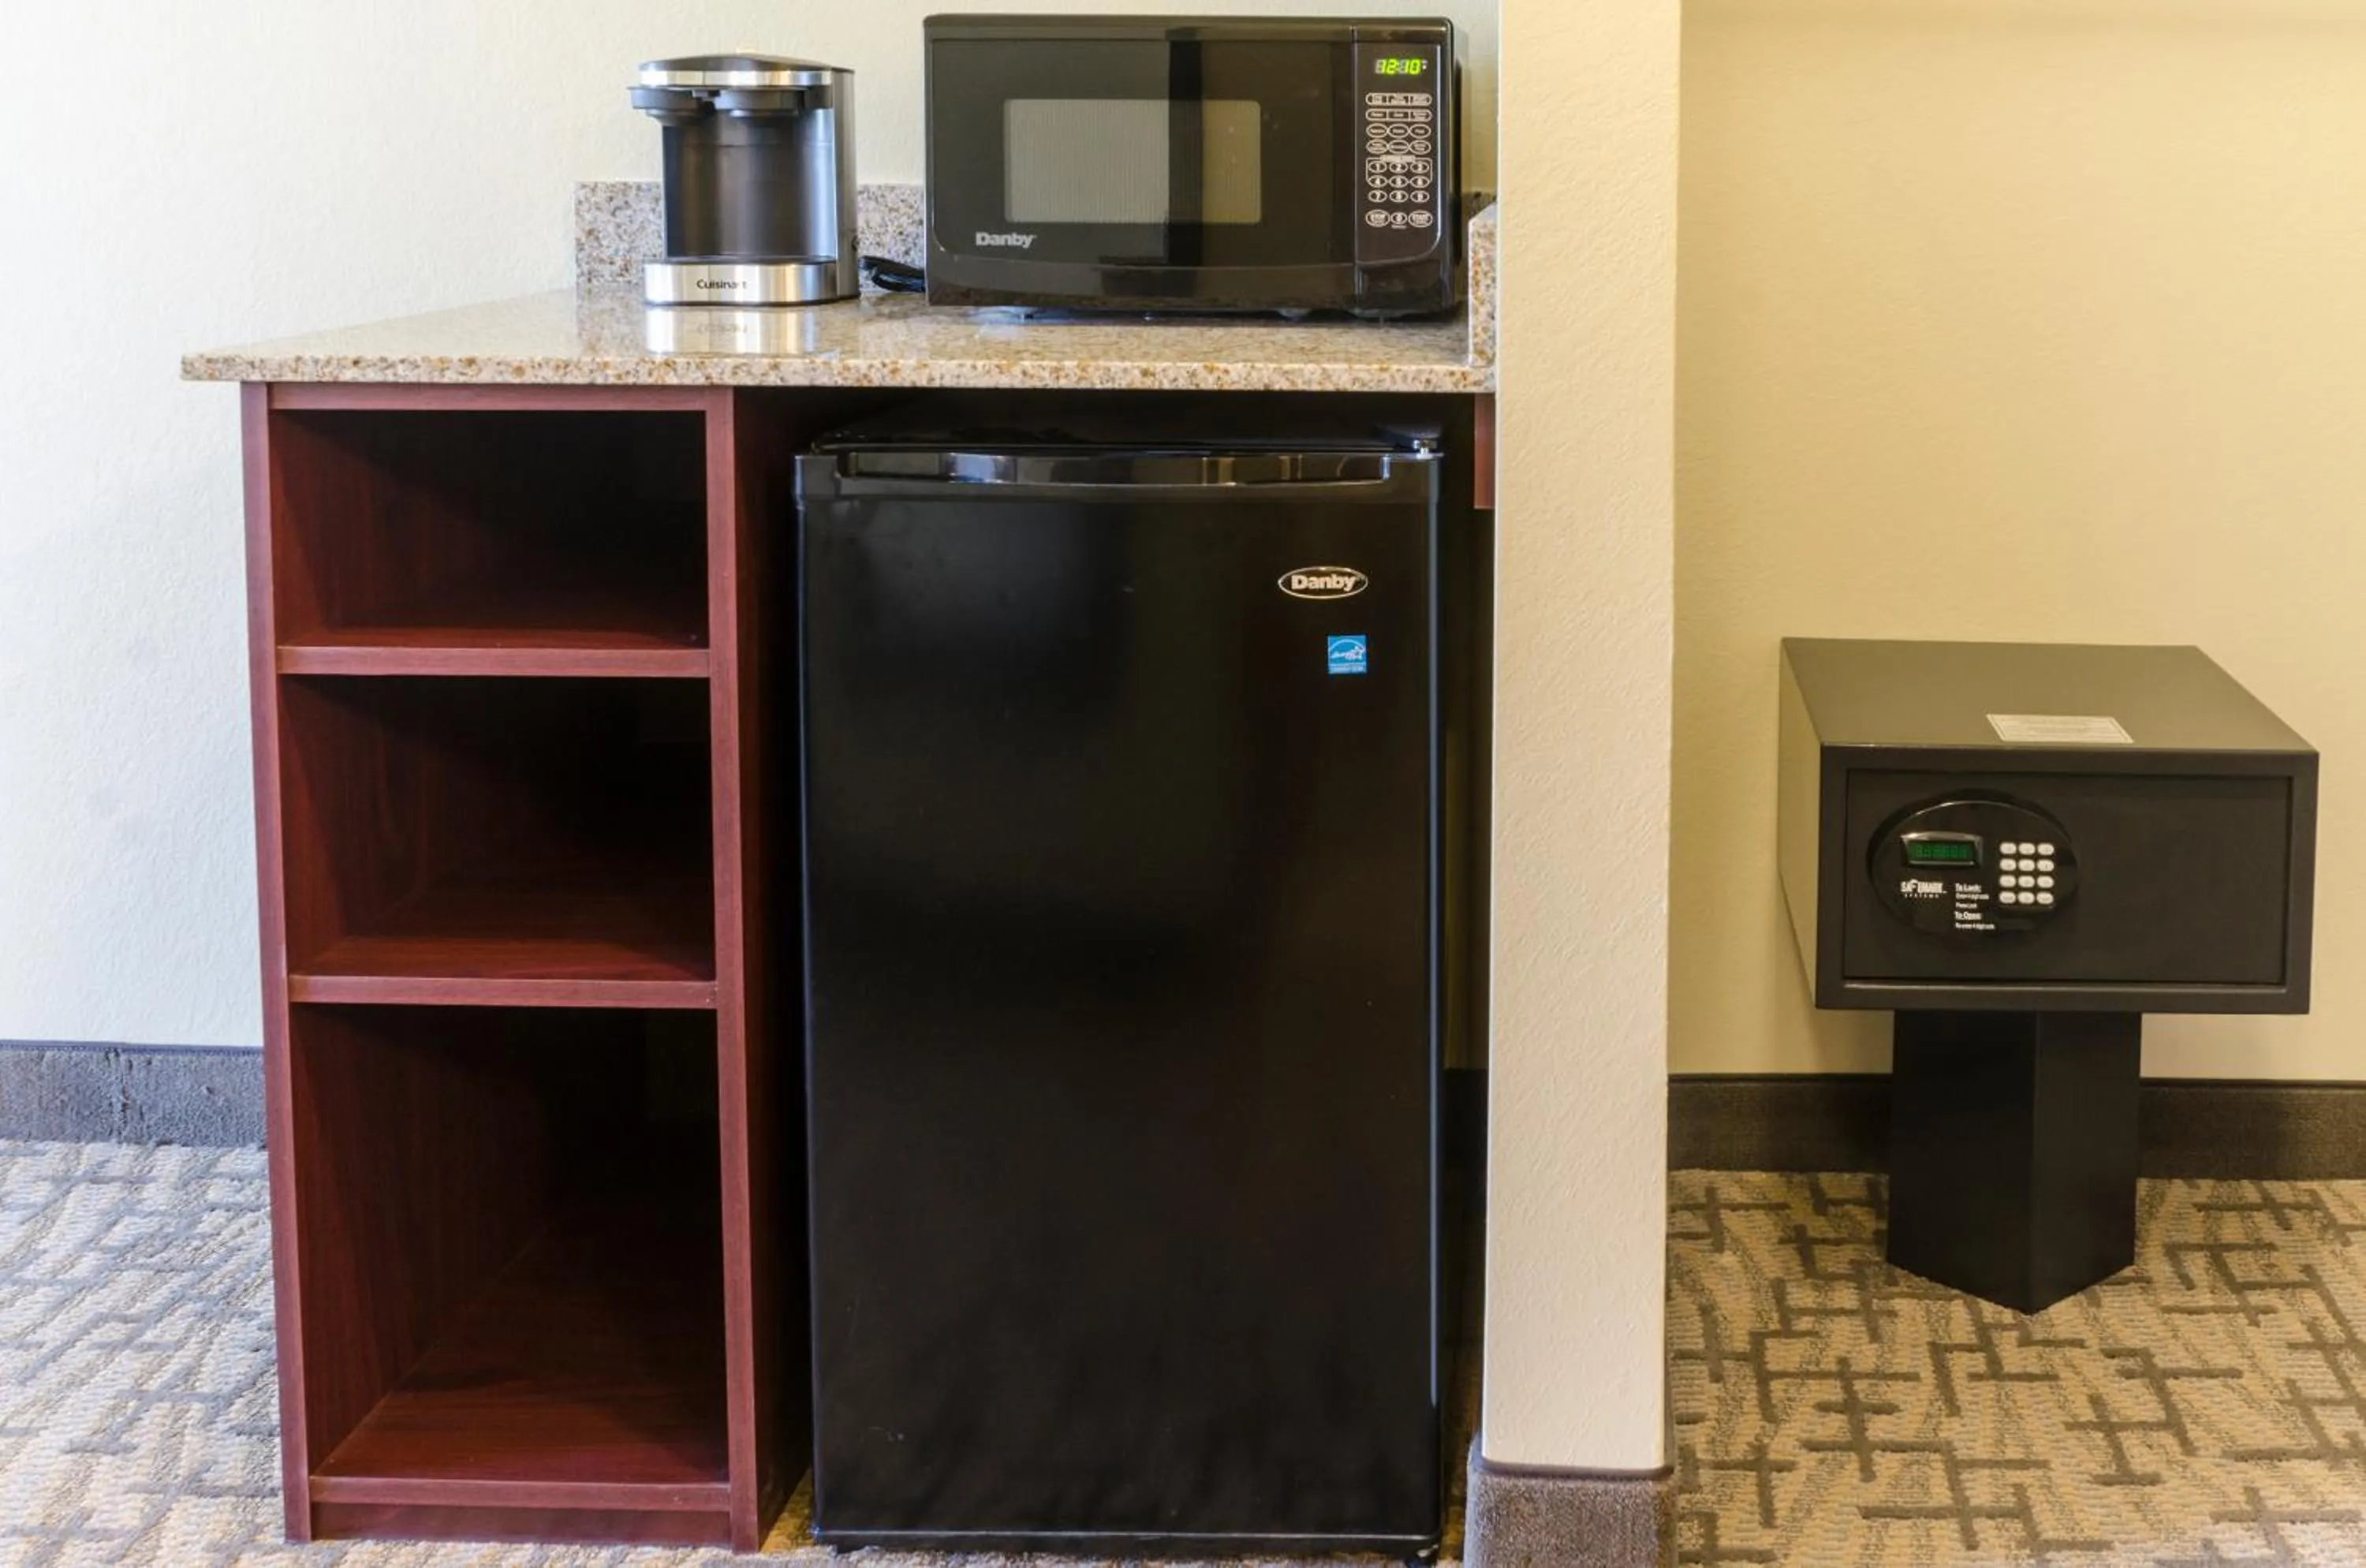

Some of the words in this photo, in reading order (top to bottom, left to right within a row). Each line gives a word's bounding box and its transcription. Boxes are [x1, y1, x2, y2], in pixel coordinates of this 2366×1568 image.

[1379, 58, 1421, 75] 12:10
[976, 232, 1037, 248] Danby
[696, 278, 747, 289] Cuisinat
[1291, 574, 1357, 592] Danby
